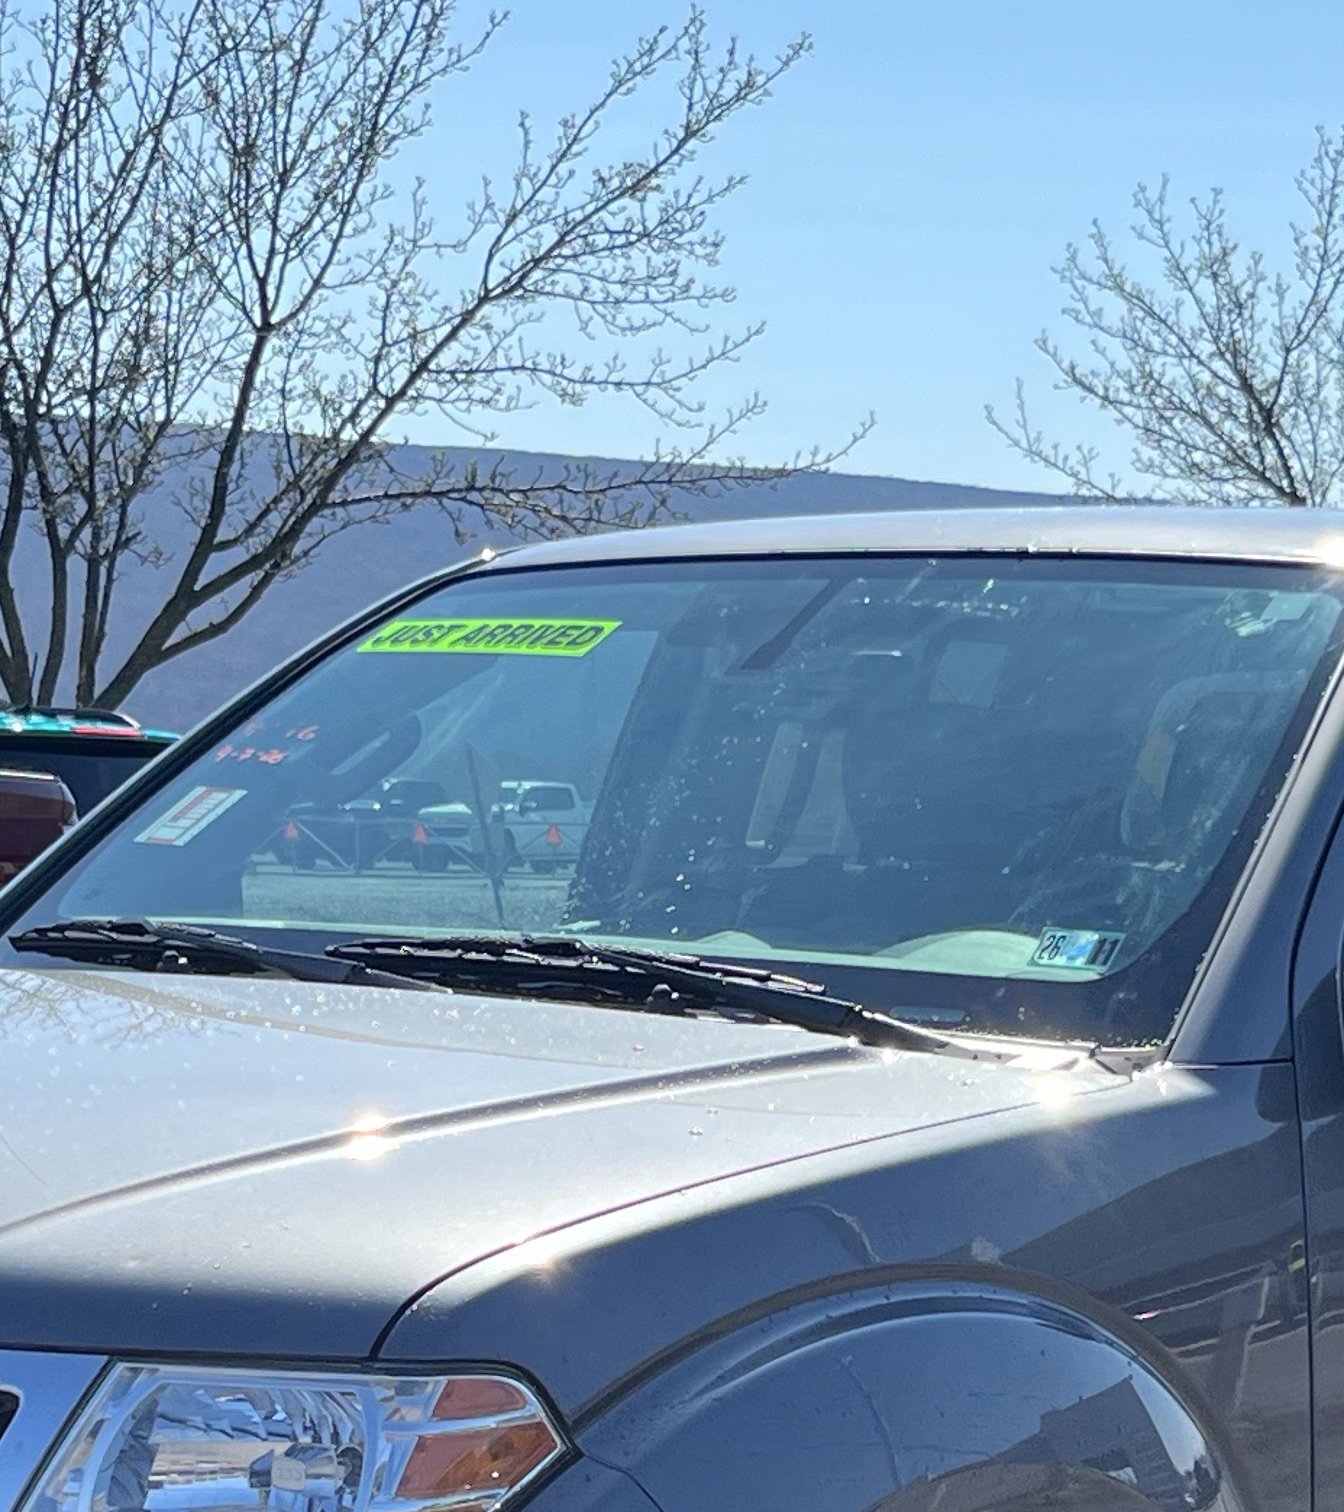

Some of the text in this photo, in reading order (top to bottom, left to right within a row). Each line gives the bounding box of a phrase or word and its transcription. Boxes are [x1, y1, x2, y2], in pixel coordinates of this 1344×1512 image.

[371, 623, 606, 651] JUST ARRIVED
[1037, 934, 1067, 960] 26
